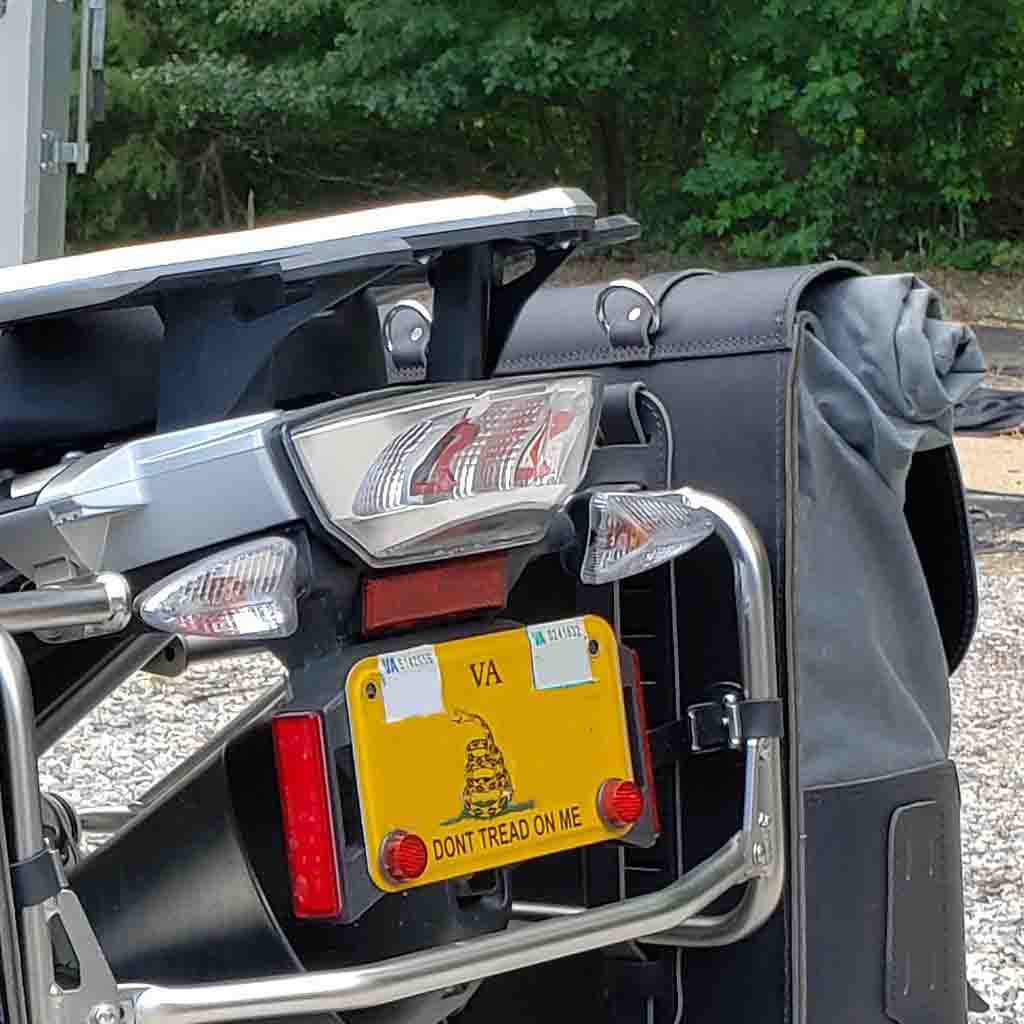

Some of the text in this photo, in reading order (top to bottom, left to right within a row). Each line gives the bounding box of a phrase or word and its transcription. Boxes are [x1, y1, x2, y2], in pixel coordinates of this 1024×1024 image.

[470, 659, 503, 688] VA
[432, 805, 583, 861] DONT TREAD ON ME
